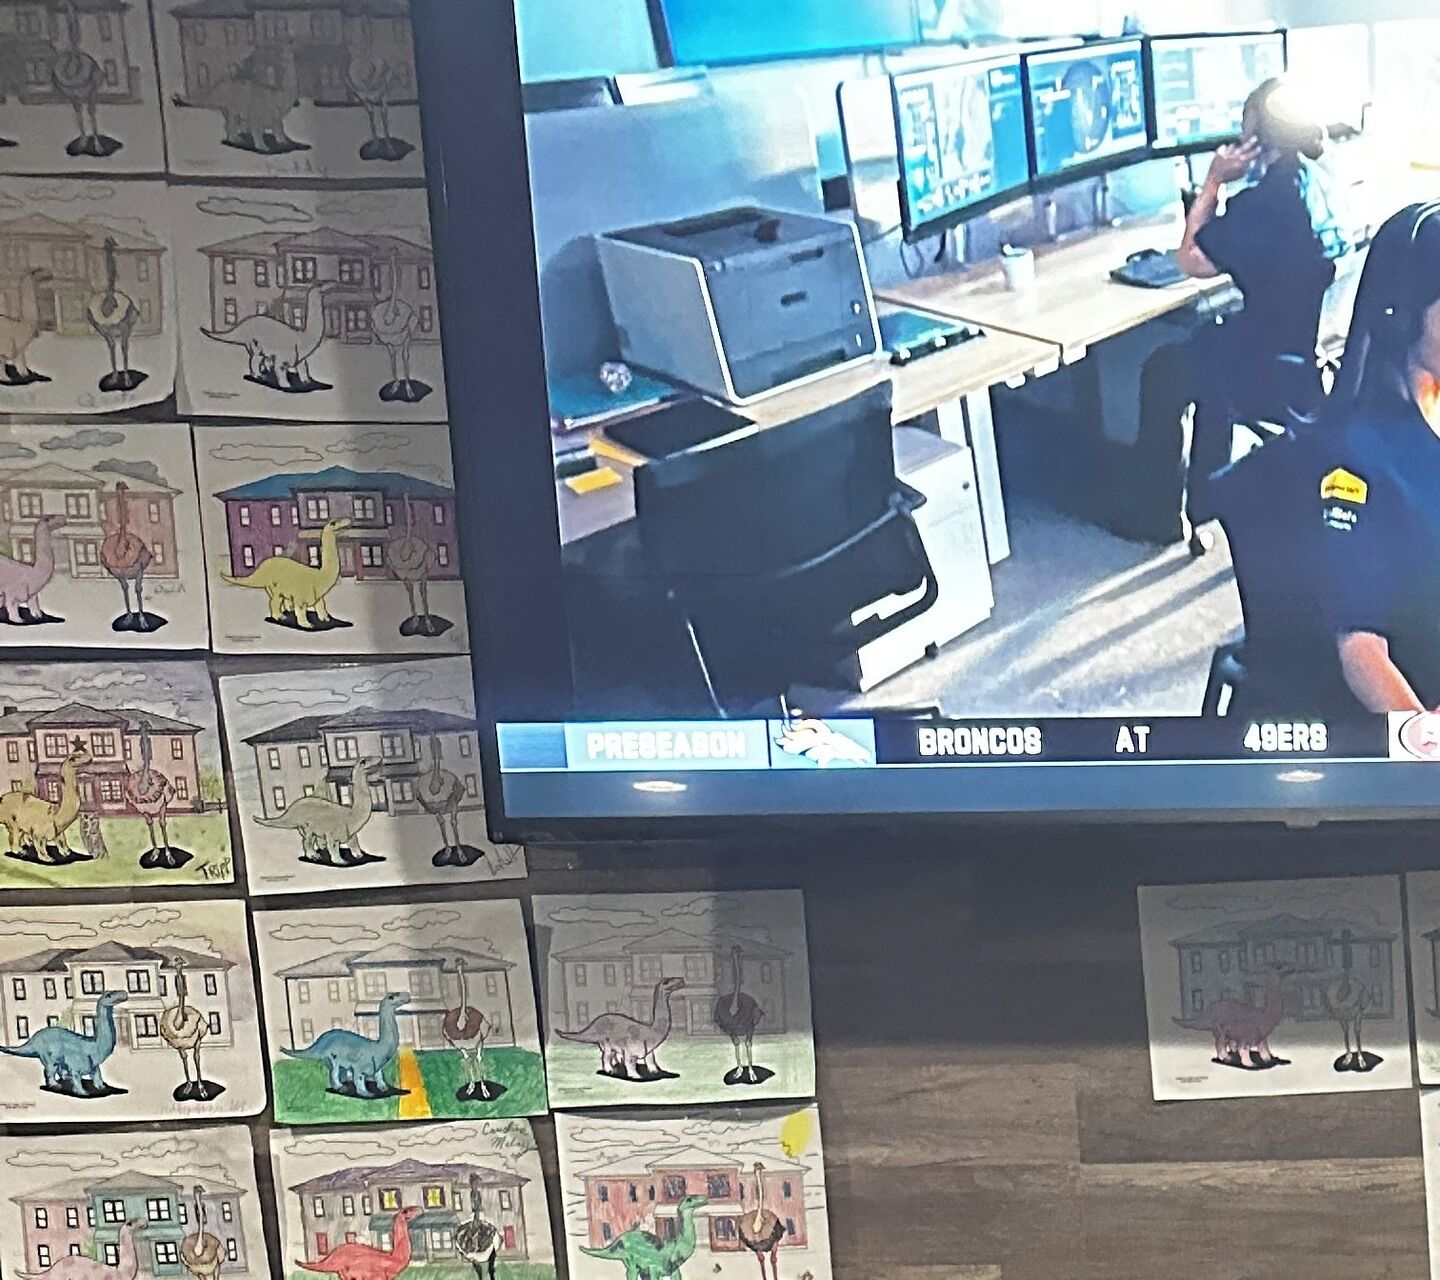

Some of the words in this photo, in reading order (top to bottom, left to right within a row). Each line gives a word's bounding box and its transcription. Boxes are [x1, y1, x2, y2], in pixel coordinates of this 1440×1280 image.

[586, 731, 747, 760] PRESEASON
[917, 726, 1043, 756] BRONCOS
[1115, 725, 1151, 754] AT
[1243, 722, 1330, 752] 49ERS
